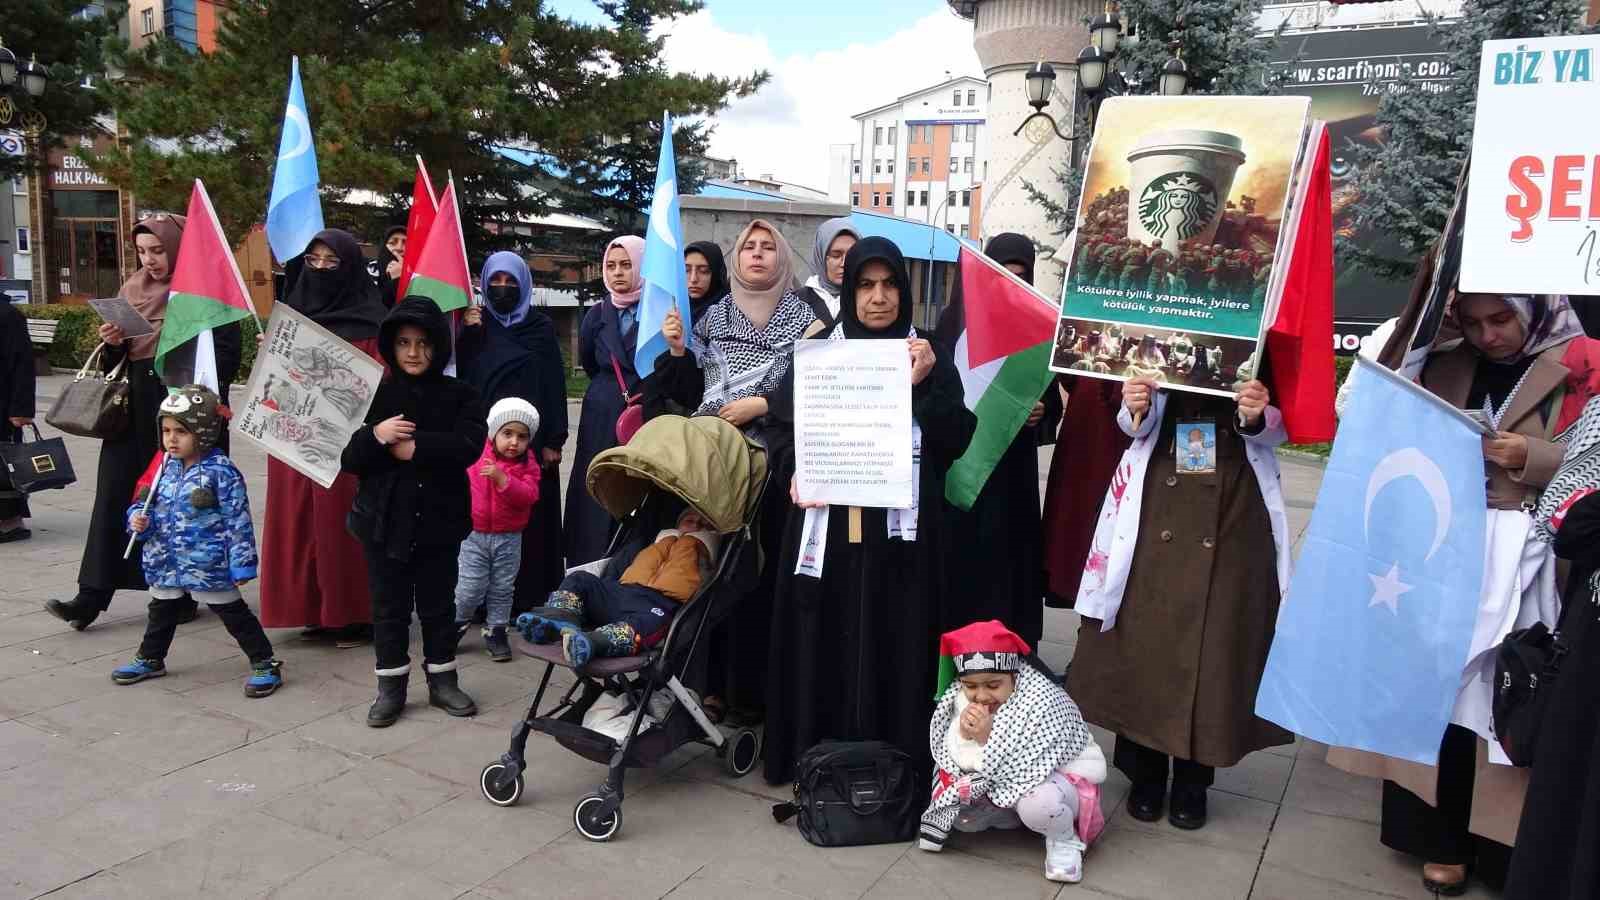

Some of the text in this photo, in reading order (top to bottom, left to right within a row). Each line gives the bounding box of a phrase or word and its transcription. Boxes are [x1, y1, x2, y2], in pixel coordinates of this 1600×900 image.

[1494, 45, 1543, 85] BİZ
[54, 171, 82, 185] HALK
[1077, 285, 1124, 297] Kötülere
[1155, 293, 1207, 307] yapmak,
[1103, 299, 1215, 319] kötülük yapmaktır.
